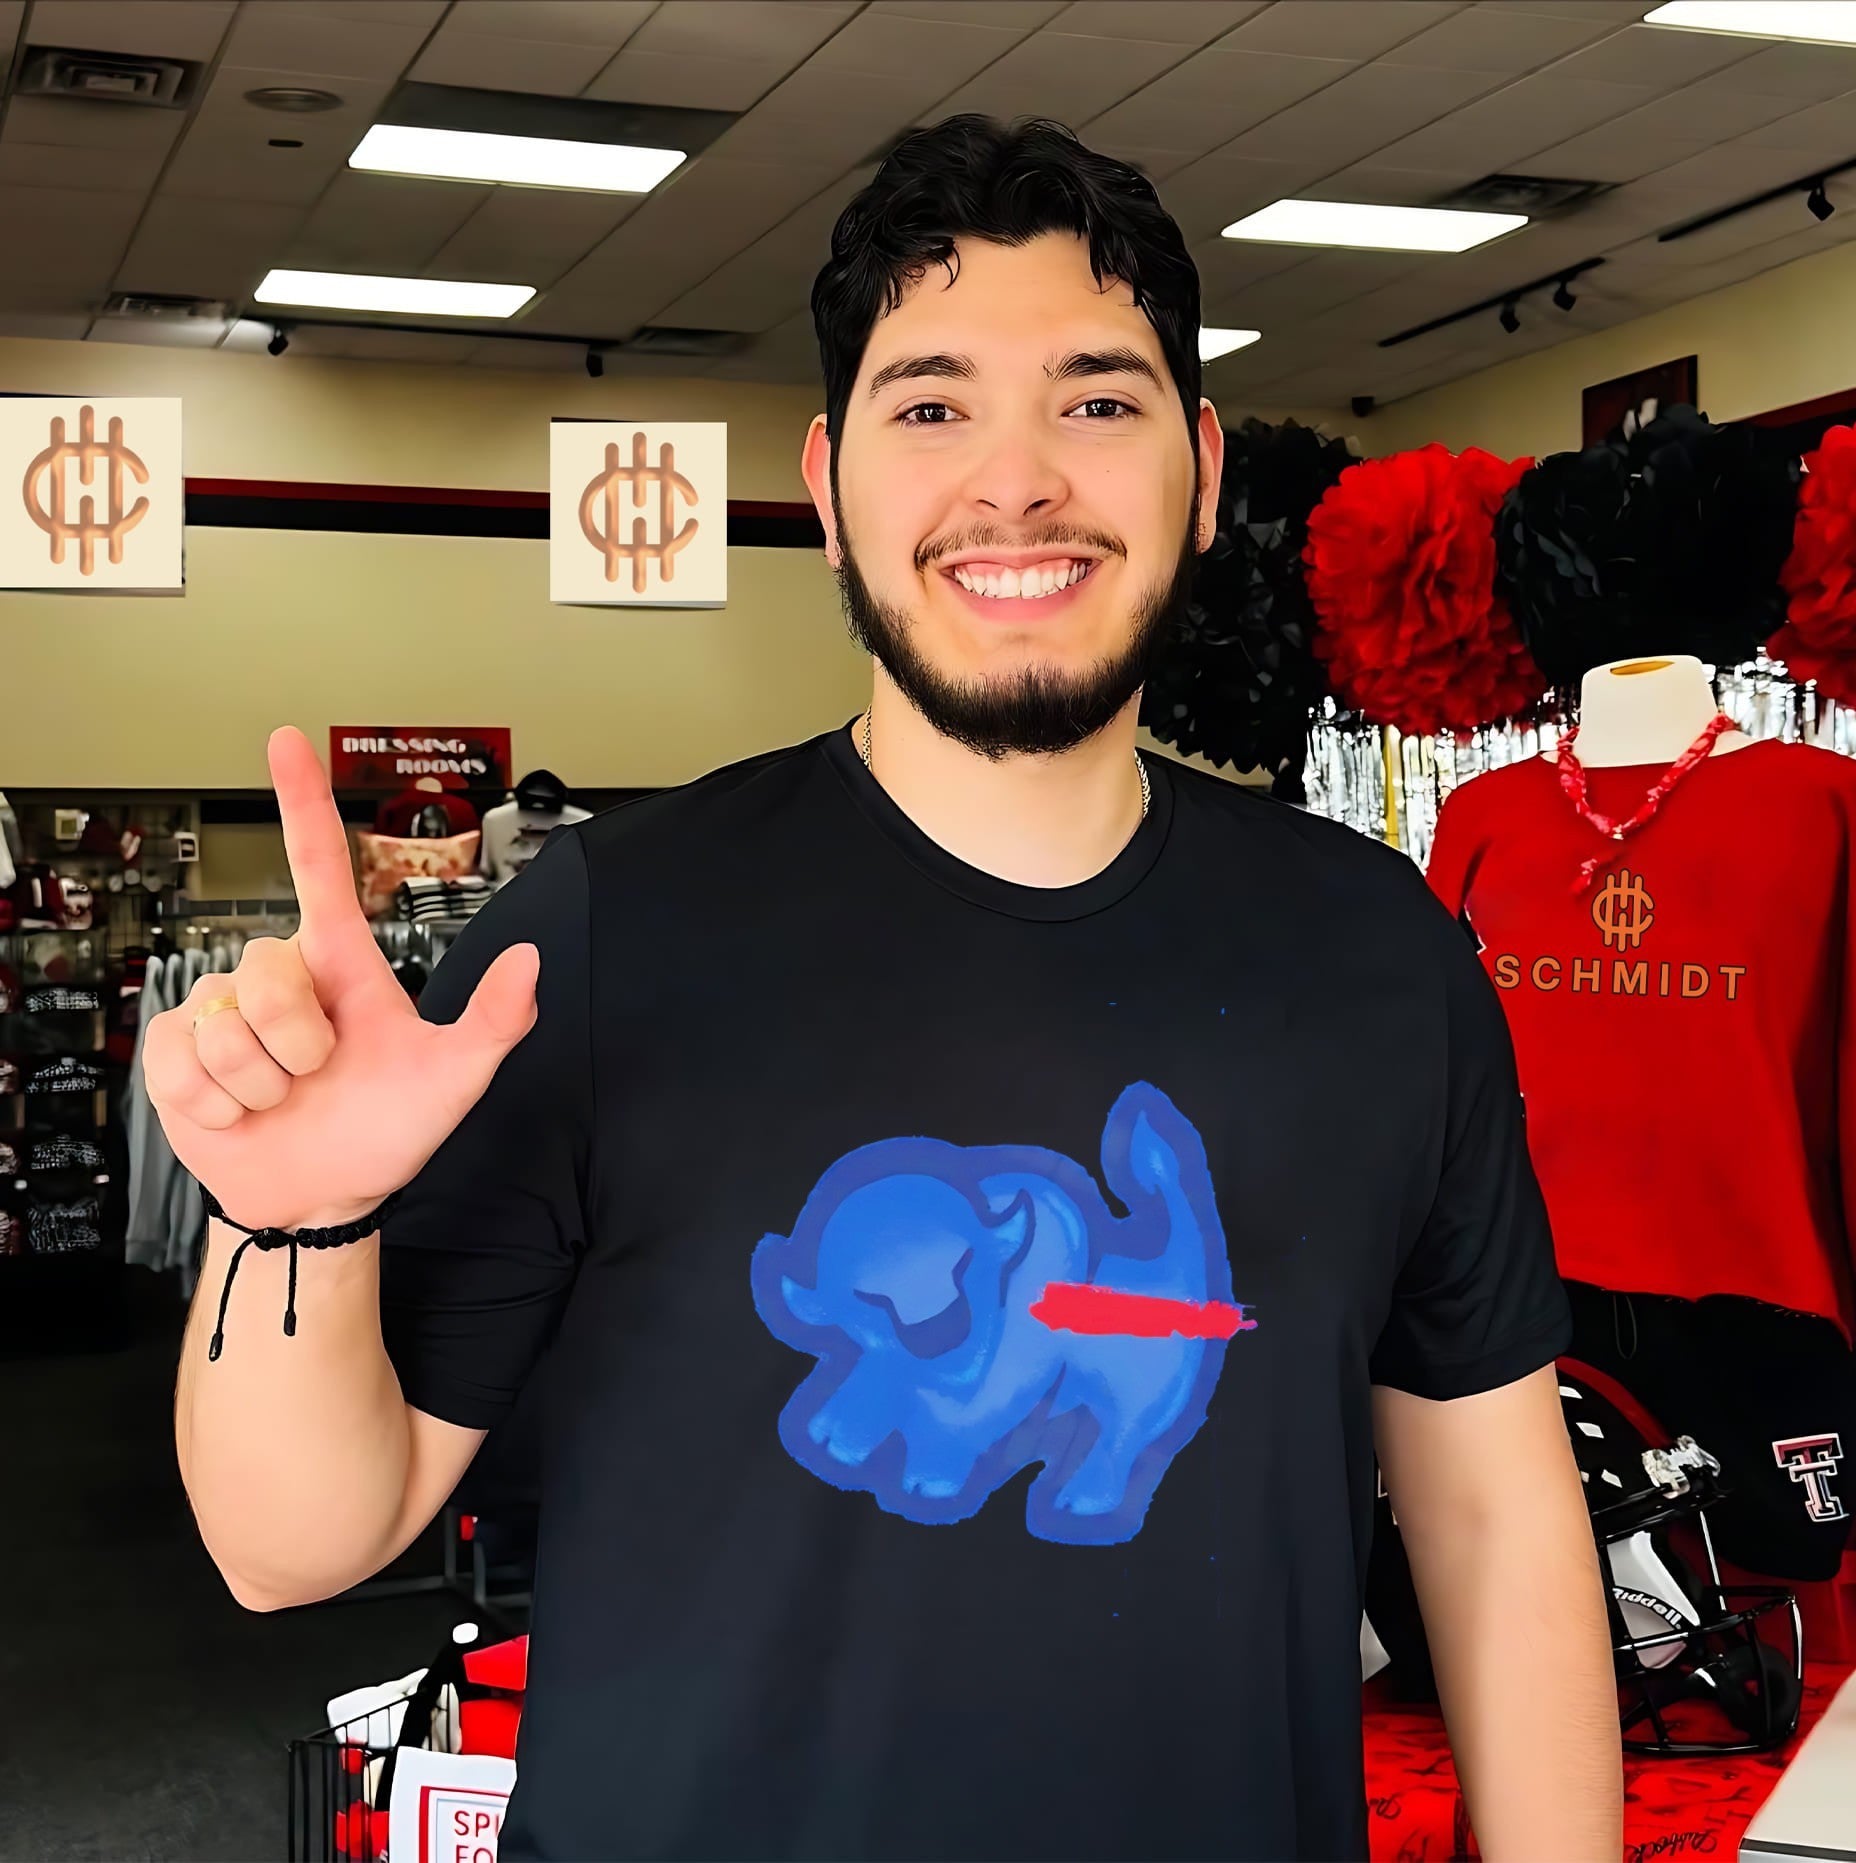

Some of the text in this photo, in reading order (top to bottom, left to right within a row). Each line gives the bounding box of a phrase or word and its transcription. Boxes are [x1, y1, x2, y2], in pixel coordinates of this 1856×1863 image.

[342, 737, 467, 754] DRESSING
[396, 758, 487, 775] ROOMS
[1494, 954, 1747, 1000] SCHMIDT
